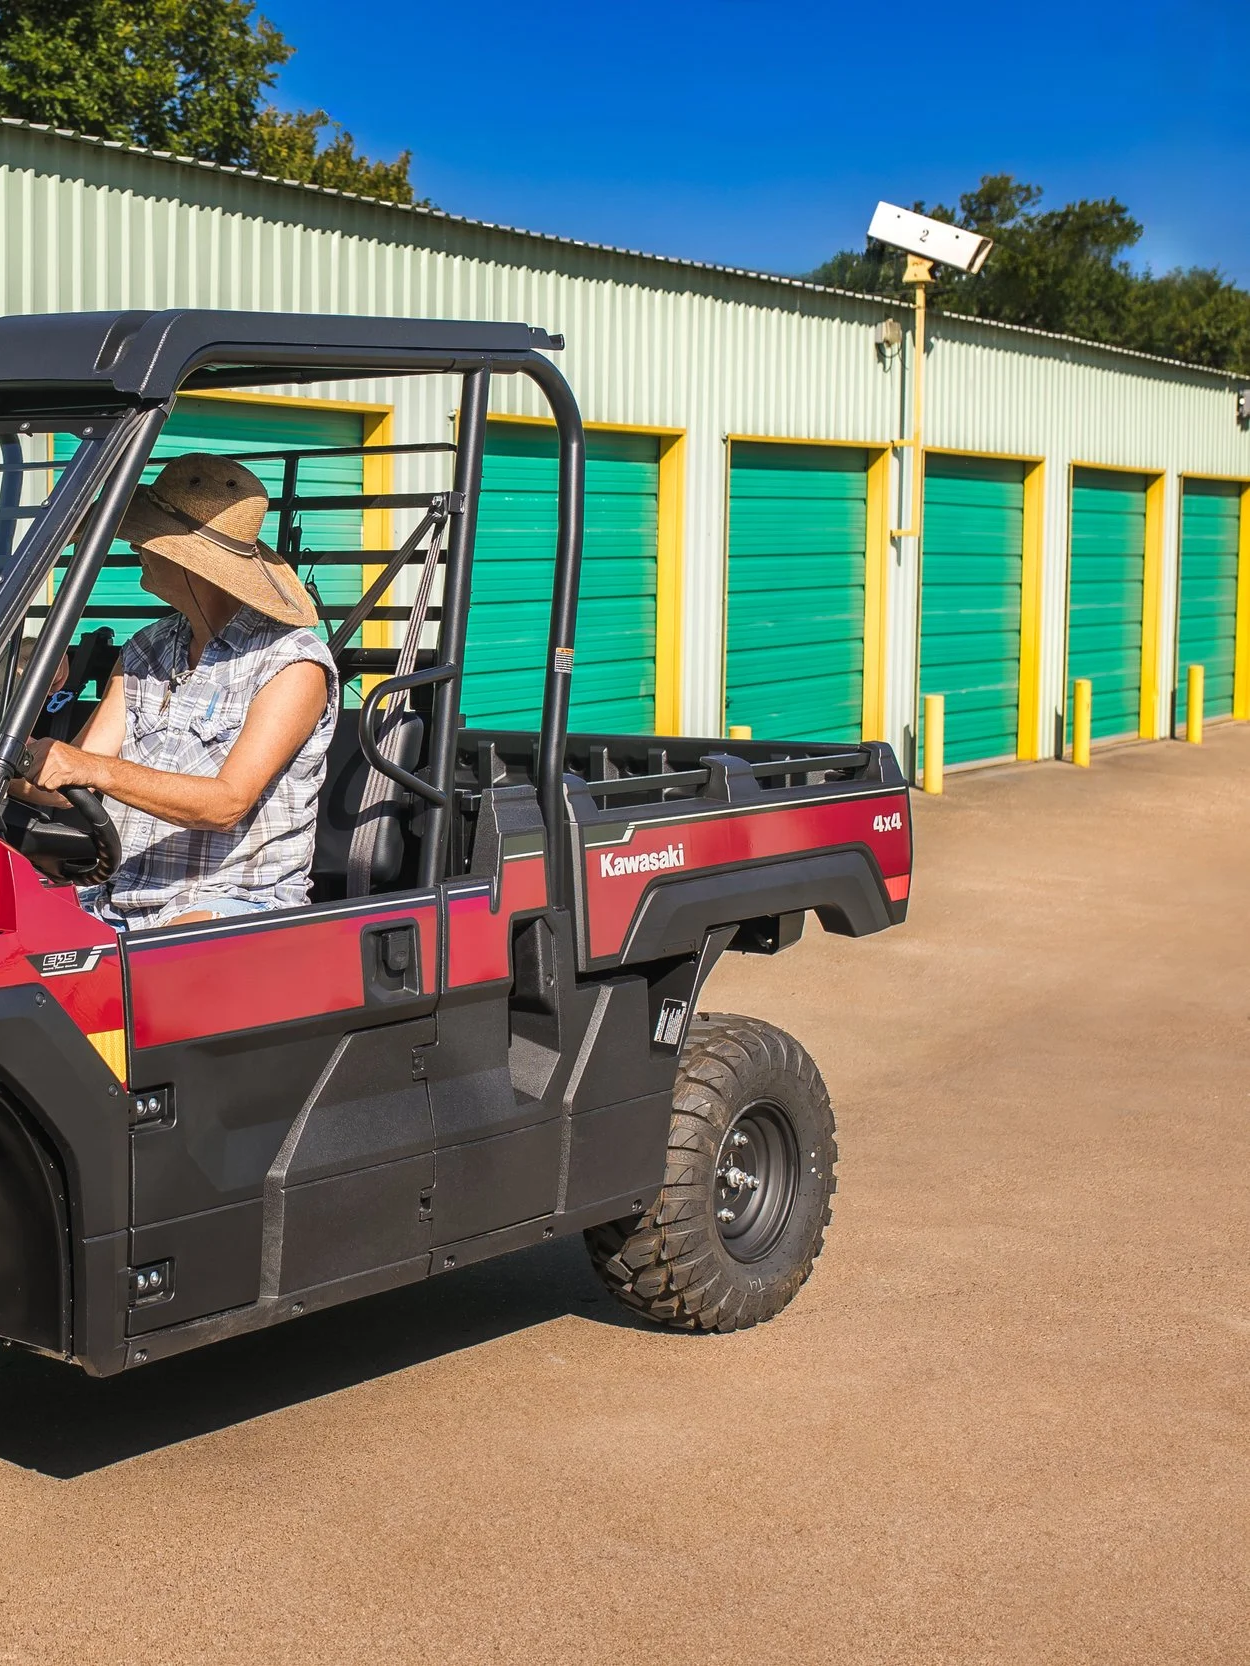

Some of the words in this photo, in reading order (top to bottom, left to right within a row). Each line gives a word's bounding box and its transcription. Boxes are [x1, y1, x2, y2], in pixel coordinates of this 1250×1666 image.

[919, 229, 930, 243] 2
[873, 812, 903, 833] 4x4
[600, 843, 685, 878] Kawasaki
[43, 951, 77, 968] EPS
